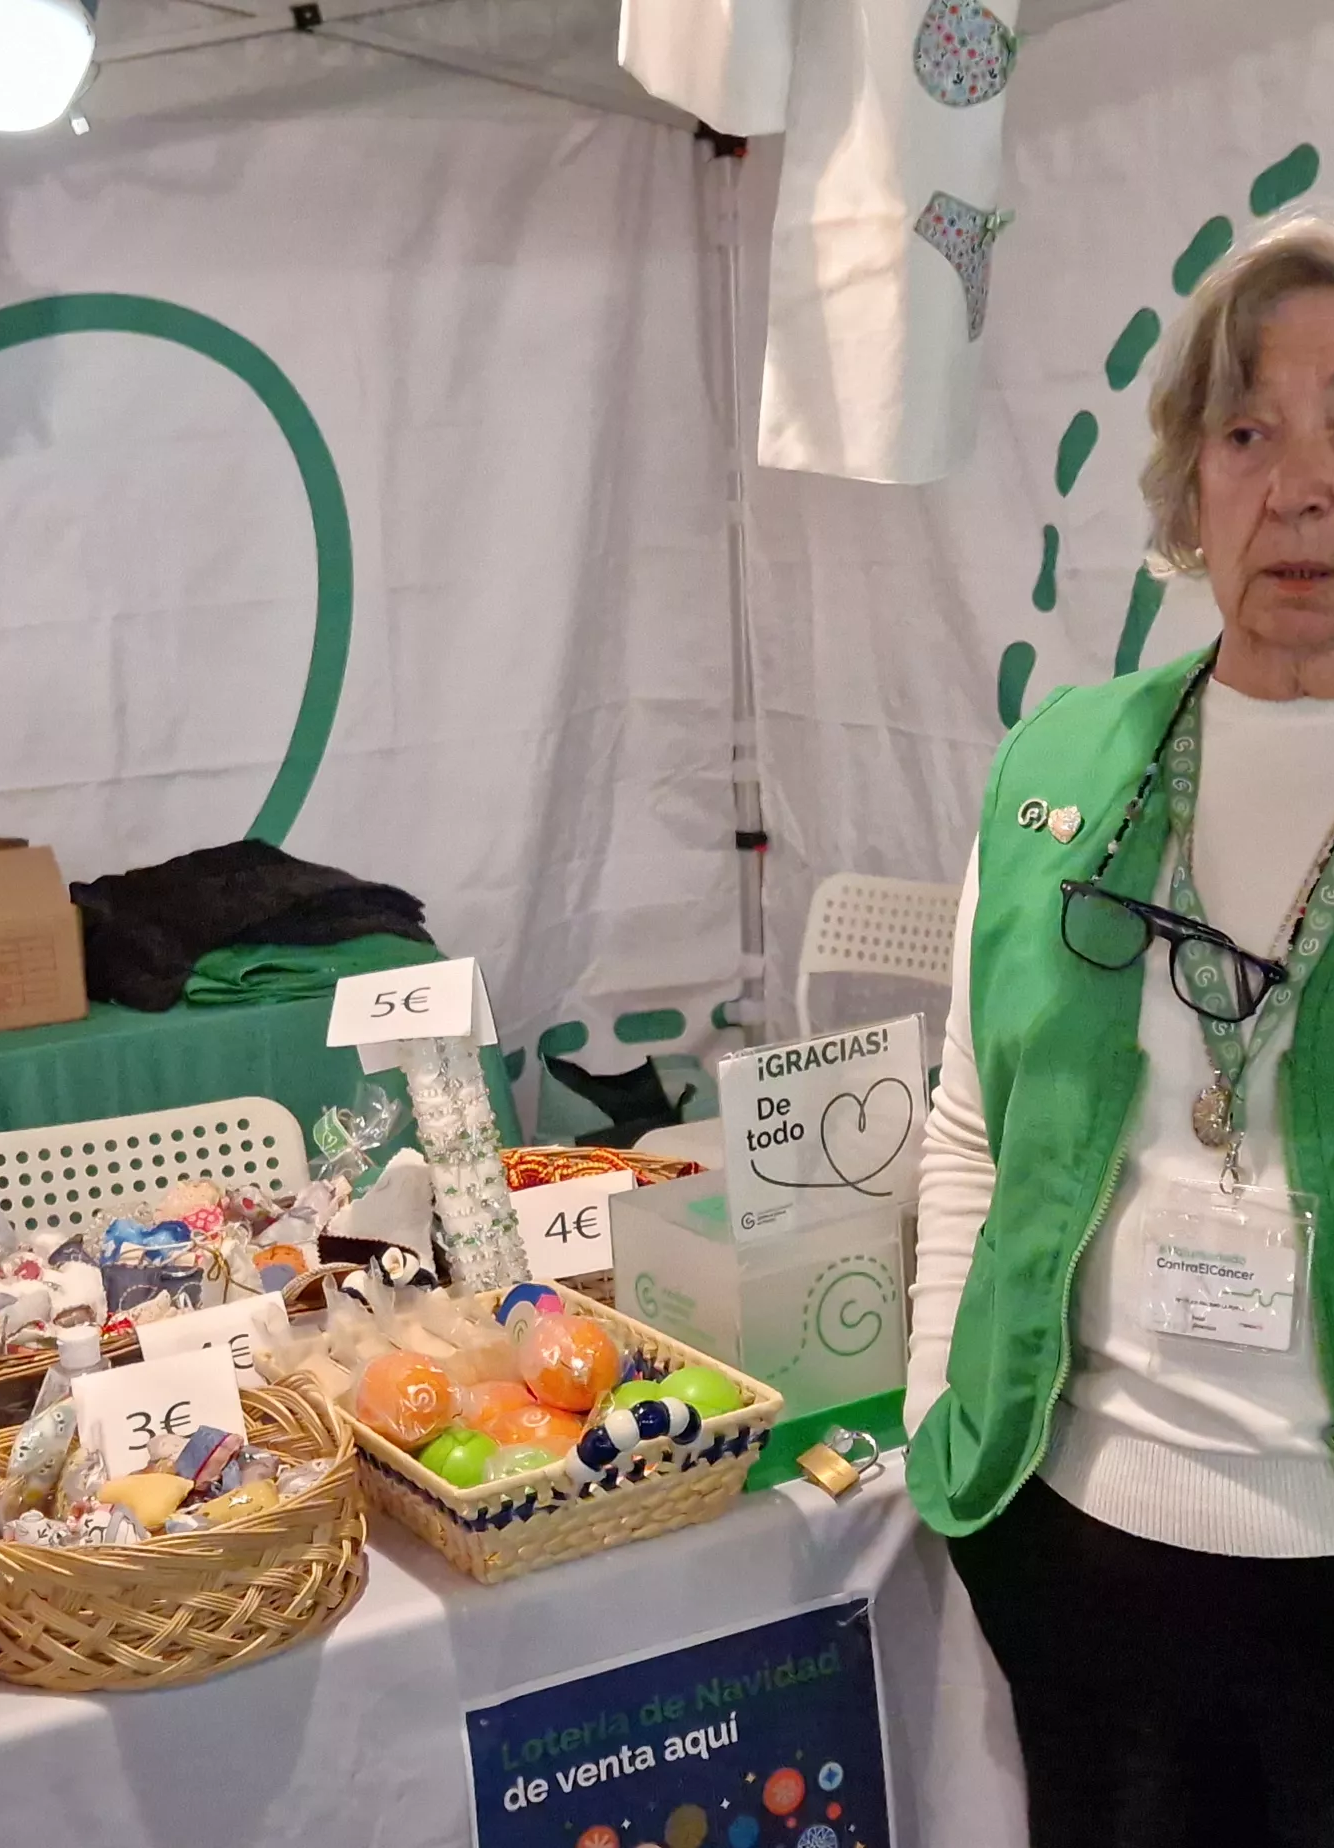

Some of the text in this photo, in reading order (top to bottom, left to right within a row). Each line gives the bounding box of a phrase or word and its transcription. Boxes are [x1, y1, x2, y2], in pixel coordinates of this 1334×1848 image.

[371, 987, 431, 1018] 5€
[757, 1029, 889, 1081] ¡GRACIAS!
[757, 1097, 791, 1120] De
[747, 1120, 805, 1152] todo
[544, 1205, 602, 1243] 4€
[126, 1401, 196, 1450] 3€
[639, 1694, 686, 1726] de
[695, 1643, 842, 1711] Navidad
[503, 1711, 739, 1812] de venta aquí
